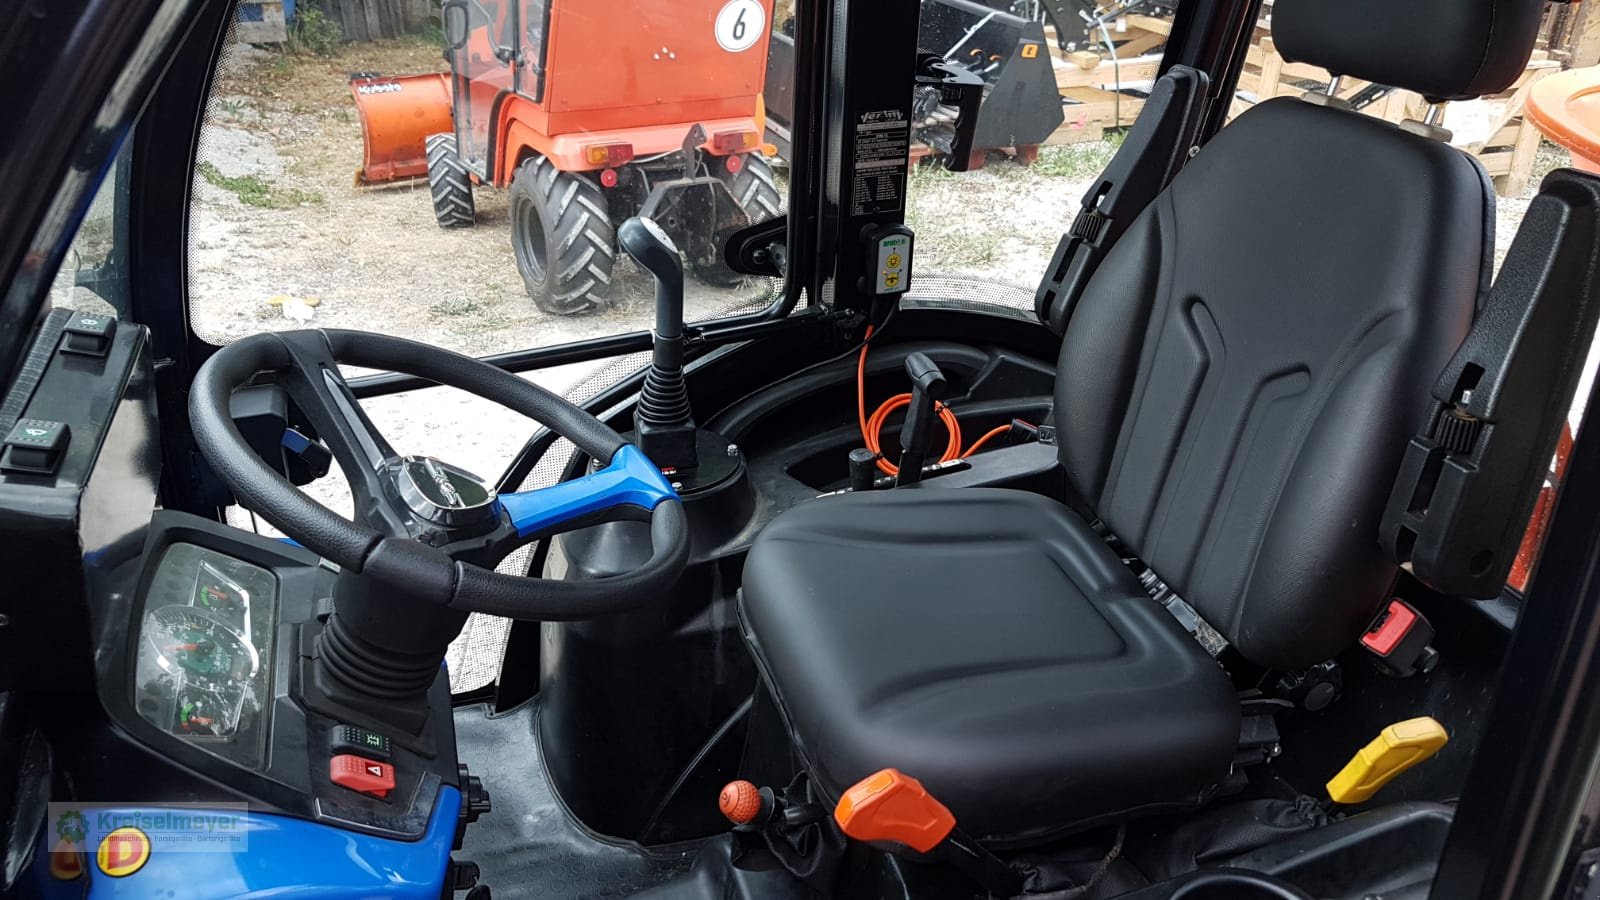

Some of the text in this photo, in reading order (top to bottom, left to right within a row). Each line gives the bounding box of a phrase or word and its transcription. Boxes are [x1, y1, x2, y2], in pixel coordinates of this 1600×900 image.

[732, 7, 747, 41] 6
[358, 82, 402, 95] Kubota
[108, 833, 143, 870] D
